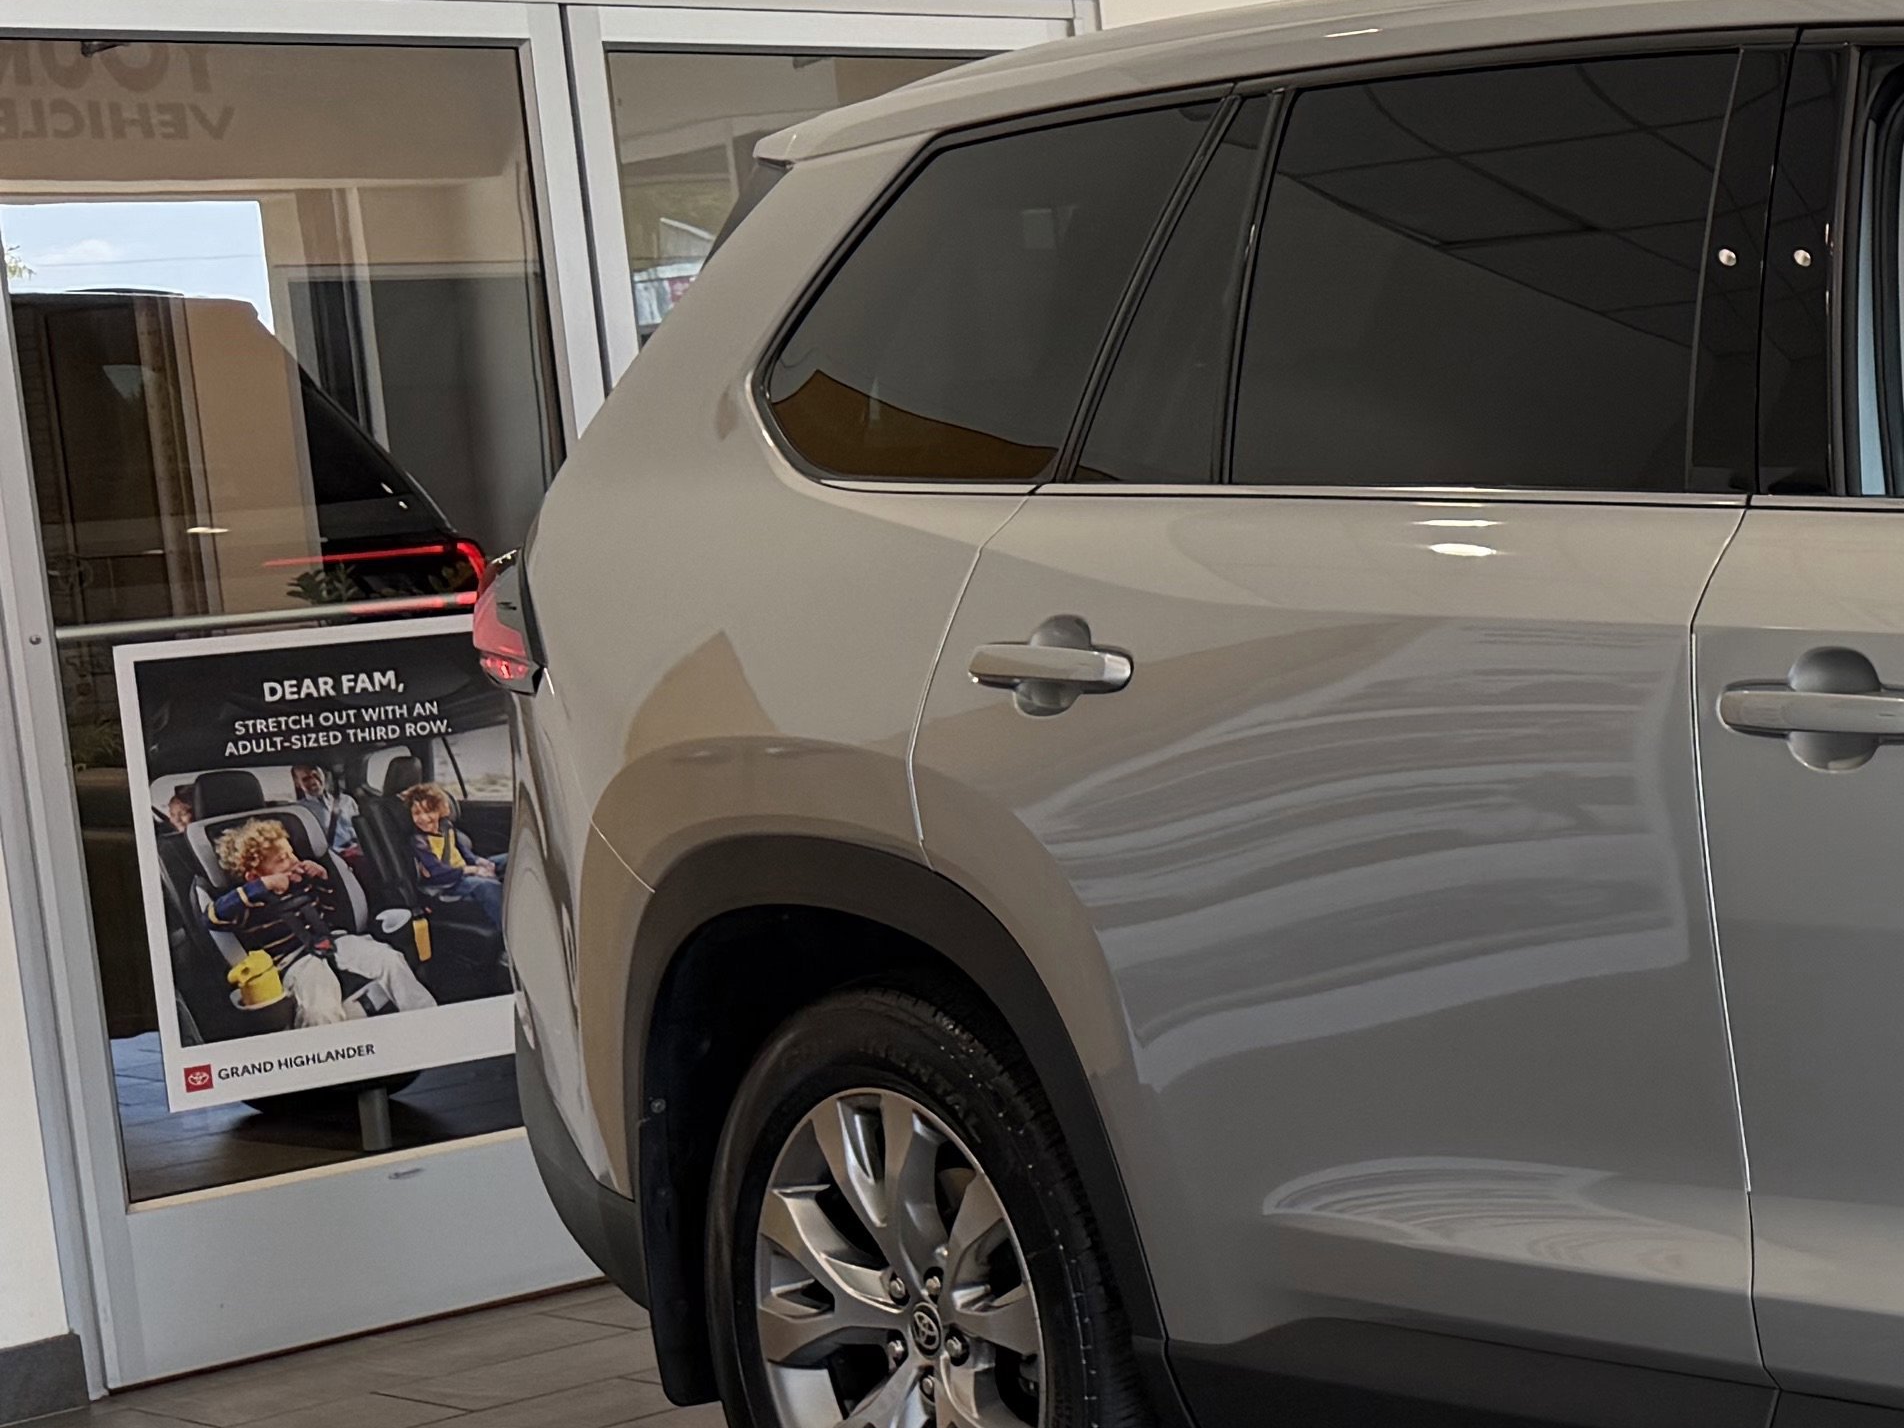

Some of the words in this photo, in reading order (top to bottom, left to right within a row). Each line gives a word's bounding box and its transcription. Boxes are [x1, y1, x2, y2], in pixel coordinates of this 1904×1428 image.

[262, 676, 336, 703] DEAR
[340, 670, 406, 695] FAM,
[234, 713, 315, 736] STRETCH
[318, 709, 358, 727] OUT
[360, 704, 408, 723] WITH
[413, 701, 439, 718] AN
[224, 730, 343, 757] ADULT-SIZED
[346, 724, 401, 744] THIRD
[405, 718, 453, 738] ROW.
[217, 1061, 274, 1081] GRAND
[277, 1043, 376, 1071] HIGHLANDER
